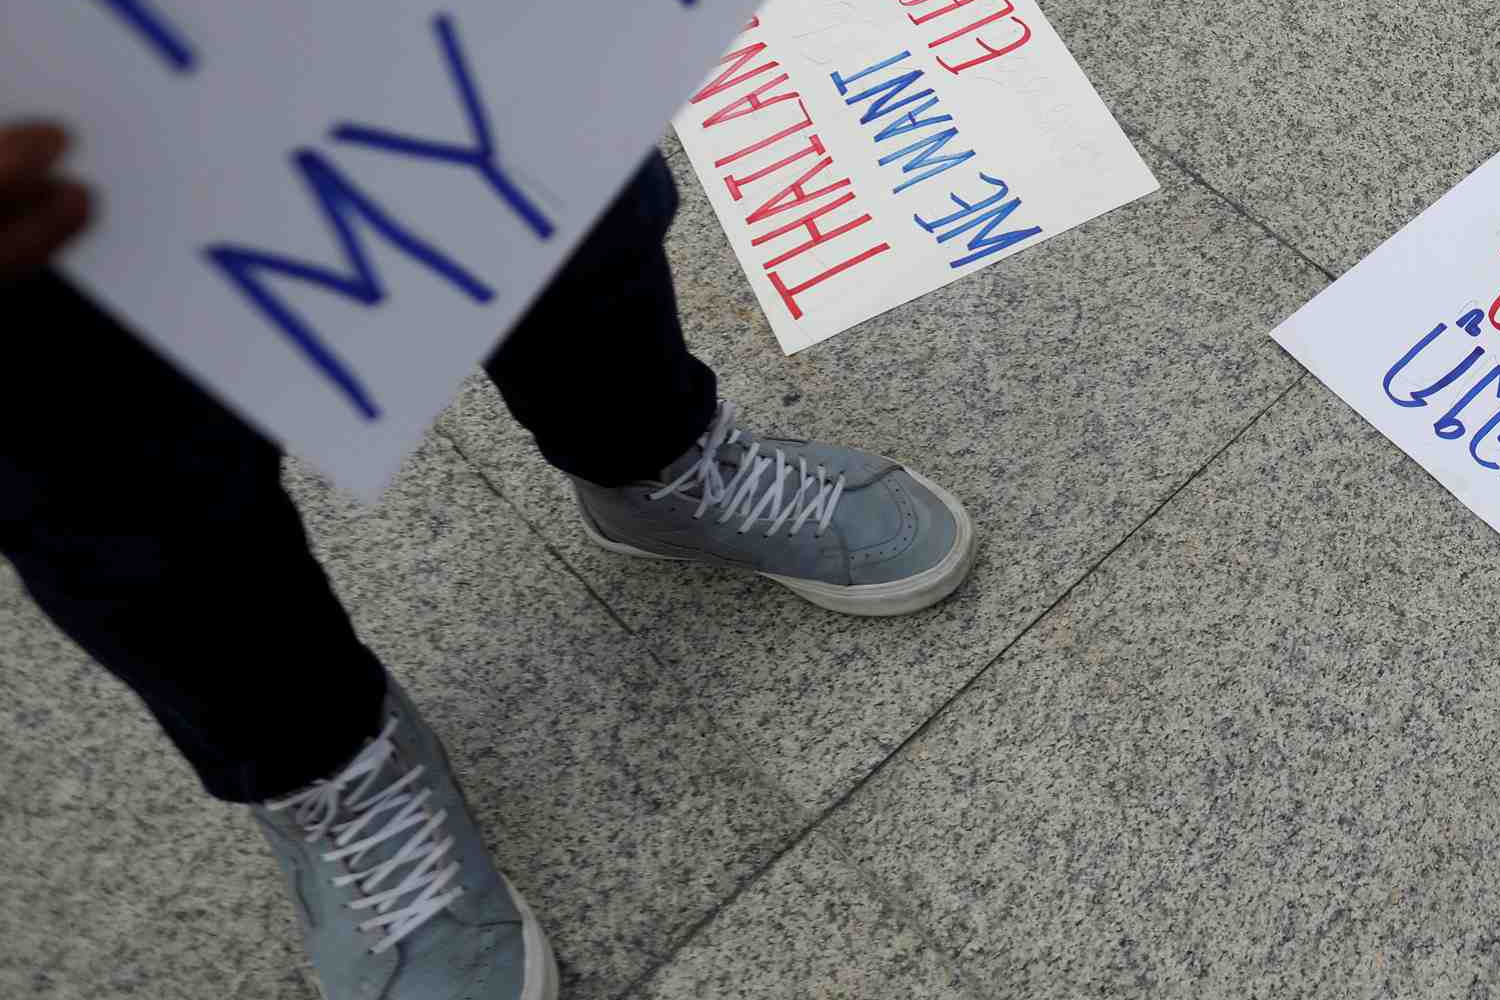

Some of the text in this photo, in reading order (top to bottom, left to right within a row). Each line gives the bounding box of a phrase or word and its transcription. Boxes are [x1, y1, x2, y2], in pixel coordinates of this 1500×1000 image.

[205, 10, 556, 422] MY
[684, 12, 891, 320] THAILAN
[830, 50, 1043, 269] WE WANT
